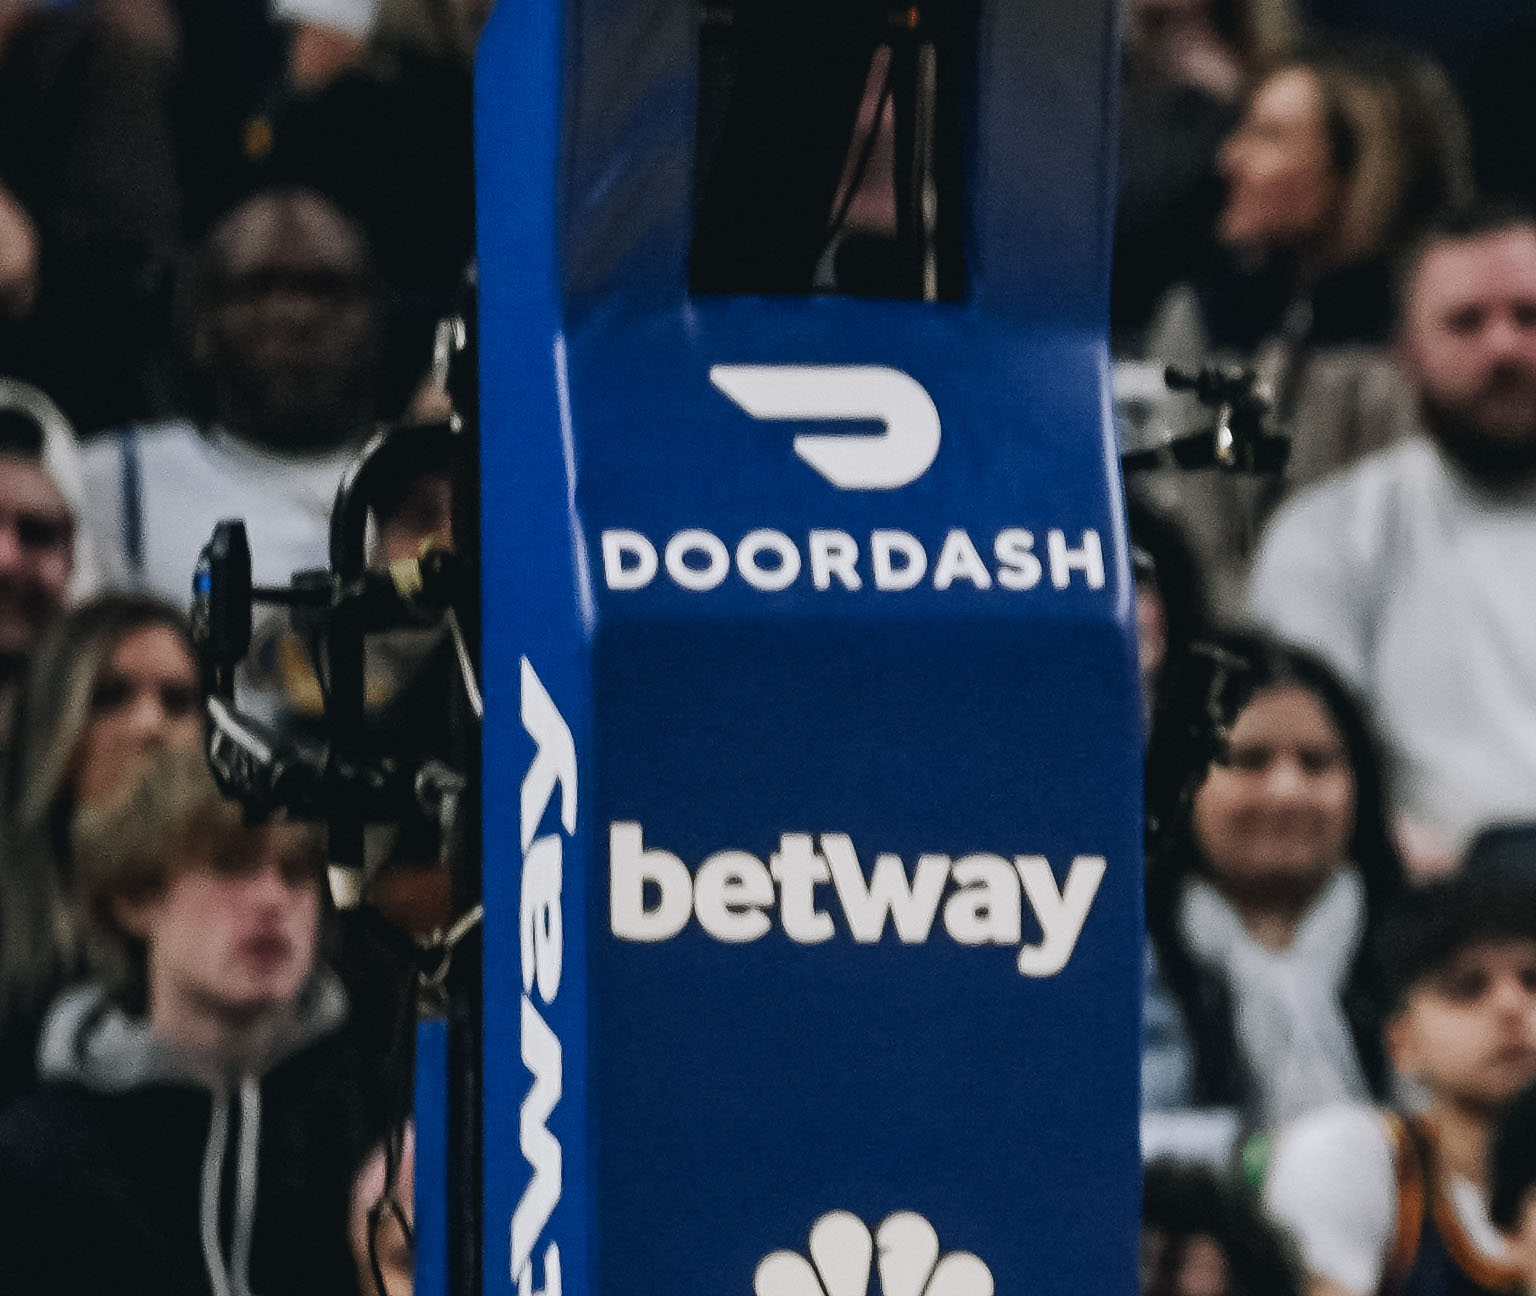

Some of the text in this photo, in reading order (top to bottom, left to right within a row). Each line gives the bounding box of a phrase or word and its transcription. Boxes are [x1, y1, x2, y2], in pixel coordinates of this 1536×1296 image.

[601, 528, 1107, 592] DOORDASH
[509, 654, 579, 1296] way
[609, 819, 1107, 979] betway
